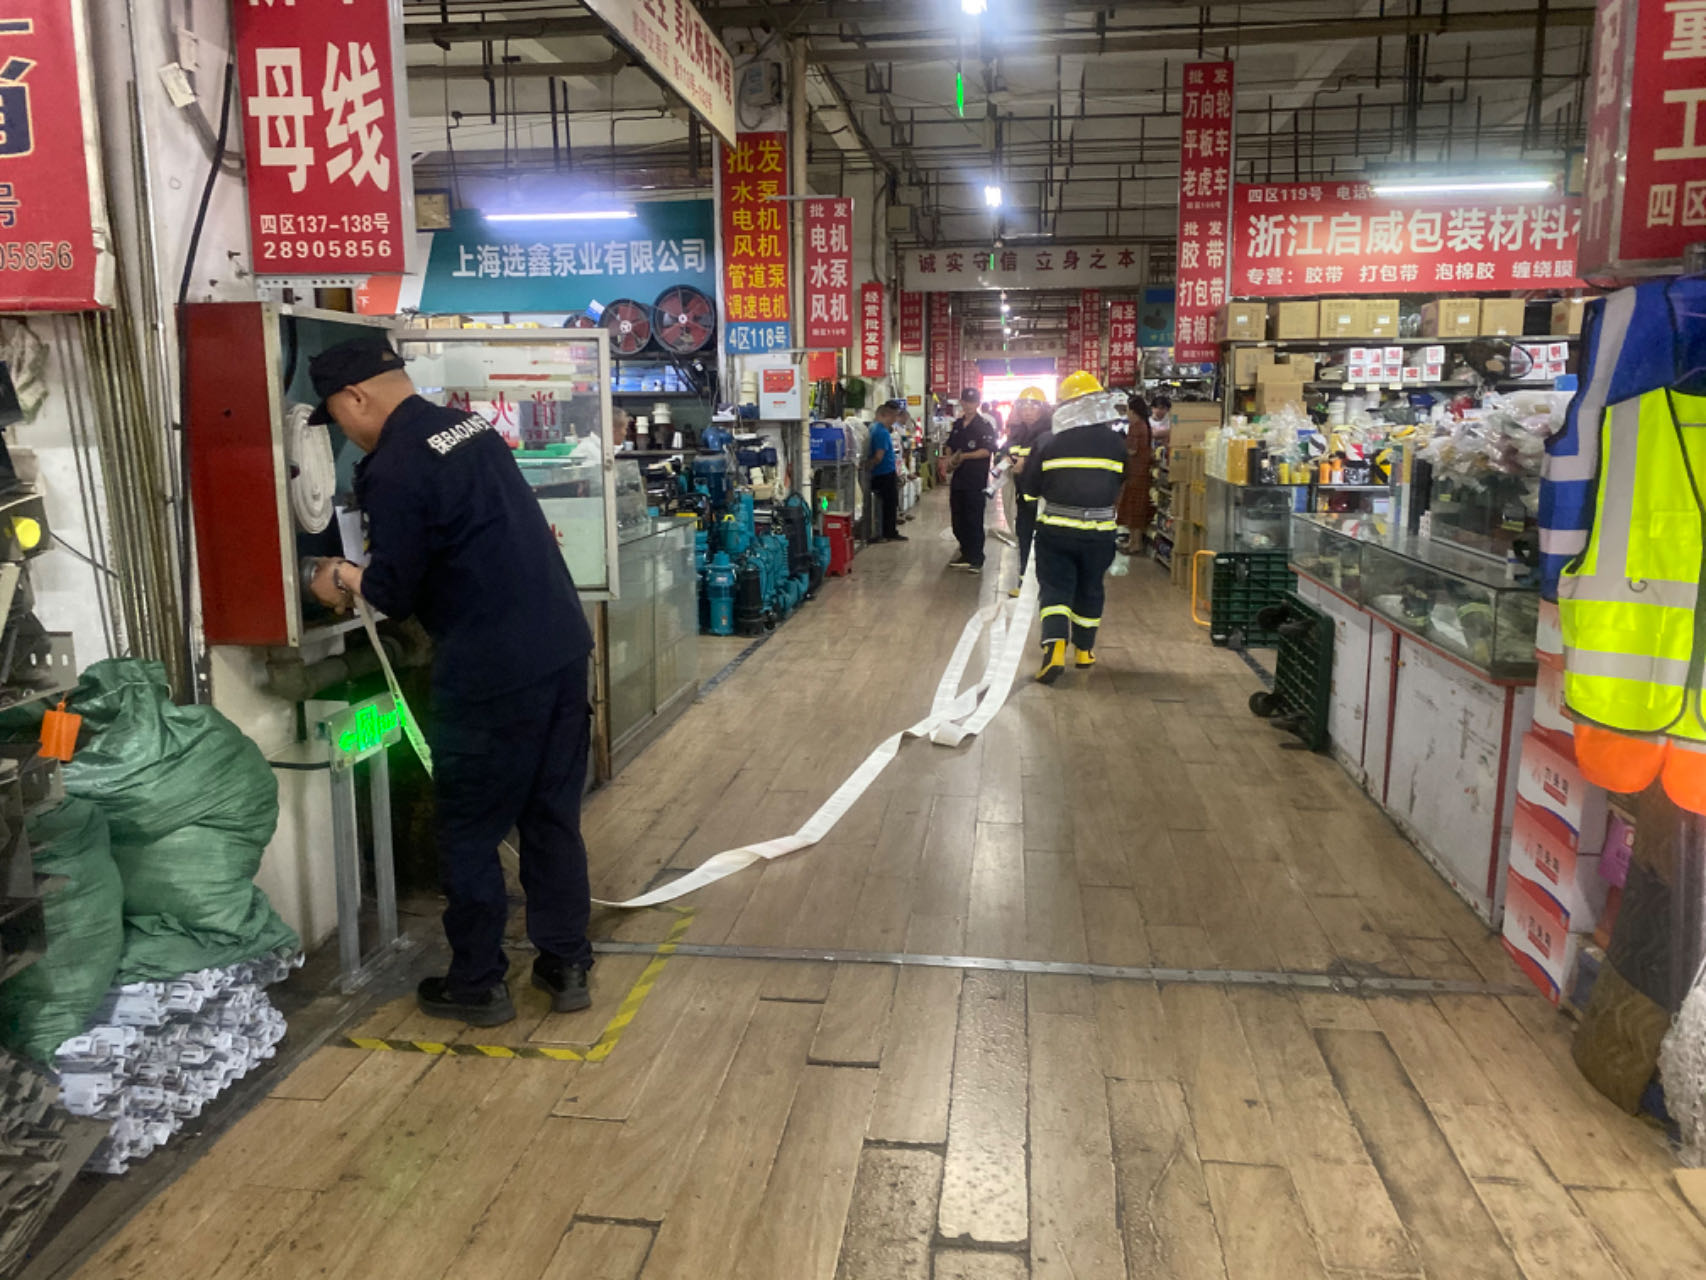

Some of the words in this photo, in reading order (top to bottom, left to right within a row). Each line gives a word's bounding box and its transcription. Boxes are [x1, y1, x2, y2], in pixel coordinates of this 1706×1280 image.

[1189, 68, 1229, 84] 批发
[1185, 89, 1231, 119] 万向轮
[248, 41, 391, 193] 母线
[1184, 128, 1229, 158] 平板车
[727, 139, 783, 173] 批发
[731, 180, 779, 203] 水泵
[1183, 166, 1228, 197] 老虎车
[1248, 186, 1323, 202] 四区119号
[732, 207, 781, 230] 电机
[810, 203, 848, 217] 批发
[260, 212, 390, 234] 四区137-138号
[1184, 220, 1222, 236] 批发
[263, 240, 392, 259] 28905856
[732, 234, 782, 257] 风机
[811, 223, 848, 253] 电机
[452, 238, 706, 279] 上海选鑫泵业有限公司
[918, 252, 1017, 273] 诚实守信
[1036, 249, 1135, 271] 立身之本
[1181, 239, 1224, 269] 胶带
[728, 263, 786, 288] 管道泵
[810, 258, 848, 288] 水泵
[1304, 266, 1343, 284] 胶带
[1359, 264, 1419, 283] 打包带
[1435, 262, 1495, 281] 泡棉胶
[1512, 260, 1574, 279] 缠绕膜
[1179, 277, 1224, 307] 打包带
[728, 294, 788, 319] 调速电机
[810, 293, 848, 322] 风机
[728, 326, 787, 350] 4区118号
[864, 291, 880, 371] 经营批发零售
